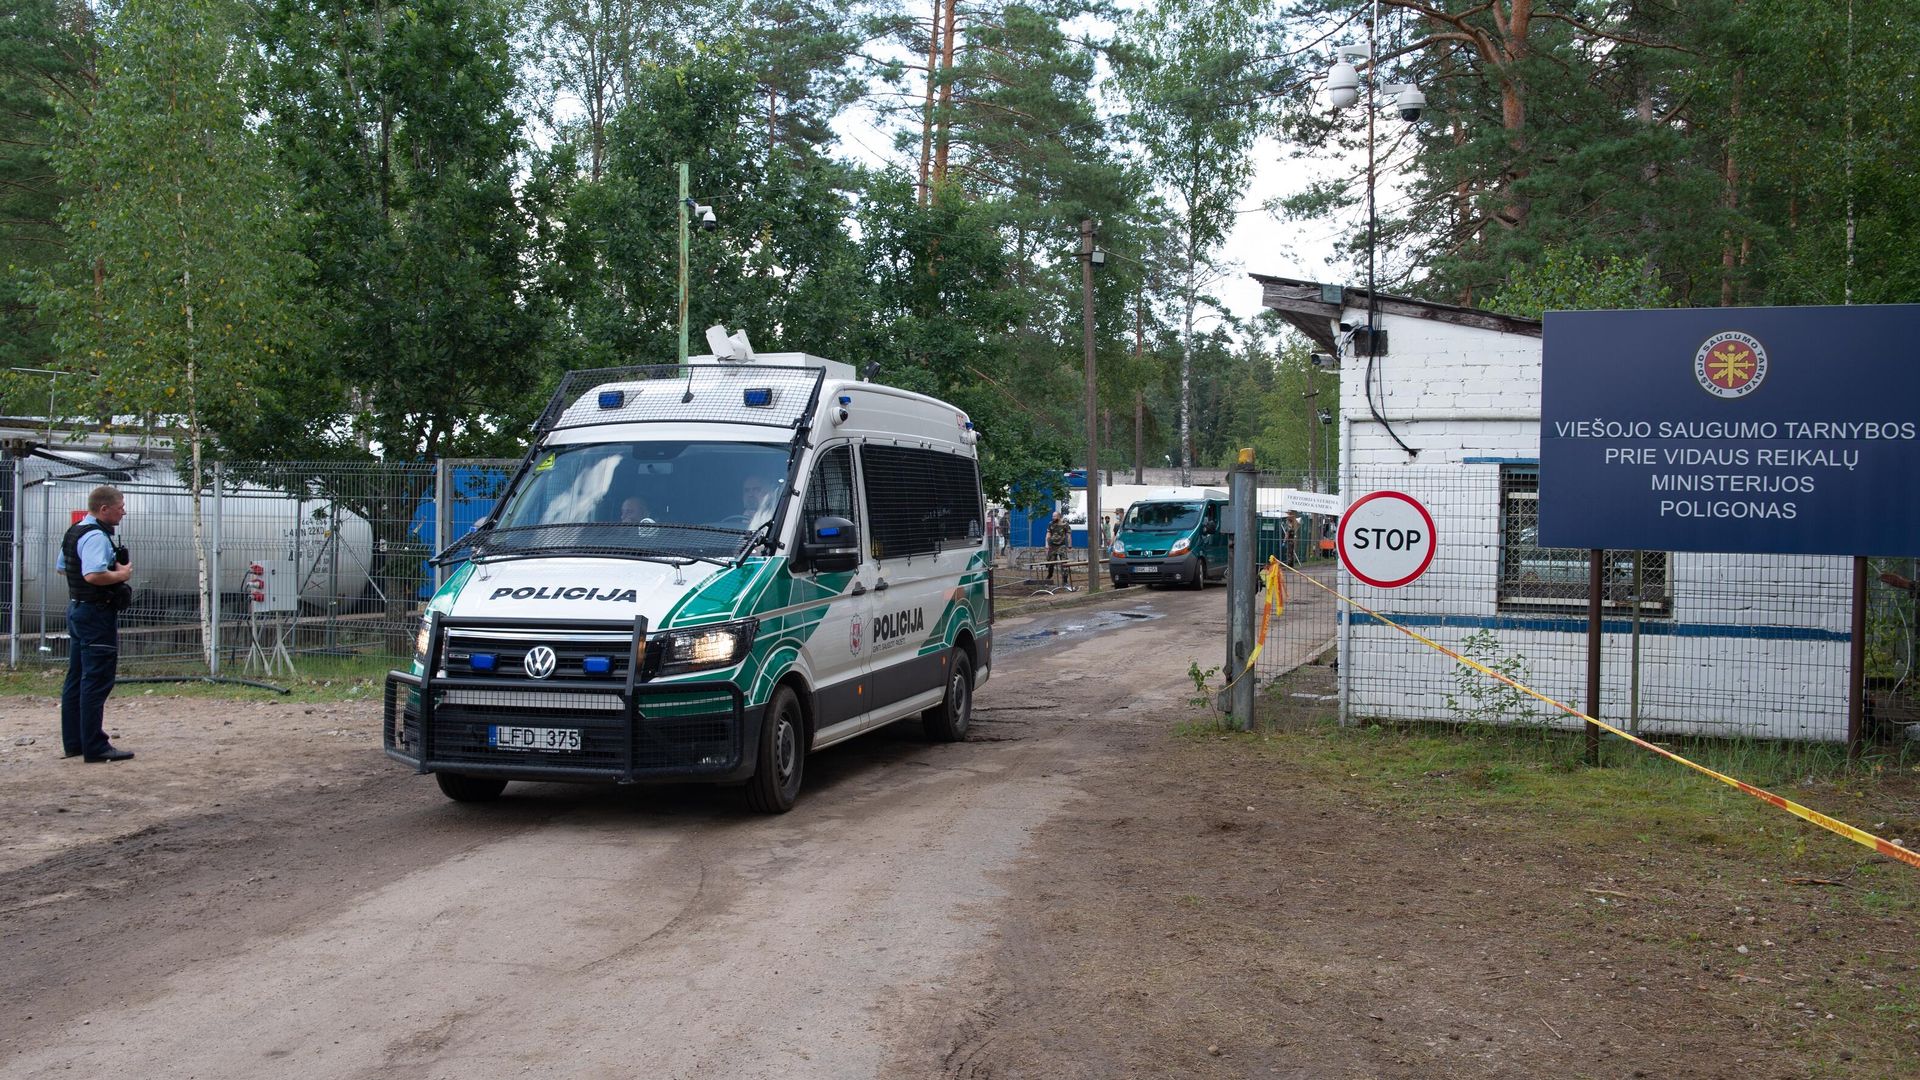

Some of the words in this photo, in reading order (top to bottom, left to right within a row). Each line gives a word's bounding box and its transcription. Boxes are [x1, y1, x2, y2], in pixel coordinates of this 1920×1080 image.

[1703, 333, 1758, 352] SAUGUMO
[1736, 350, 1765, 394] TARNYBA
[1555, 417, 1652, 439] VIEŠOJO
[1658, 421, 1778, 439] SAUGUMO
[1783, 421, 1916, 440] TARNYBOS
[1605, 448, 1657, 465] PRIE
[1663, 448, 1750, 466] VIDAUS
[1757, 449, 1859, 471] REIKALŲ
[1651, 474, 1815, 493] MINISTERIJOS
[1660, 500, 1797, 519] POLIGONAS
[1353, 527, 1422, 551] STOP
[488, 586, 637, 603] POLICIJA
[873, 606, 924, 643] POLICIJA
[498, 726, 536, 746] LFD
[547, 730, 579, 748] 375
